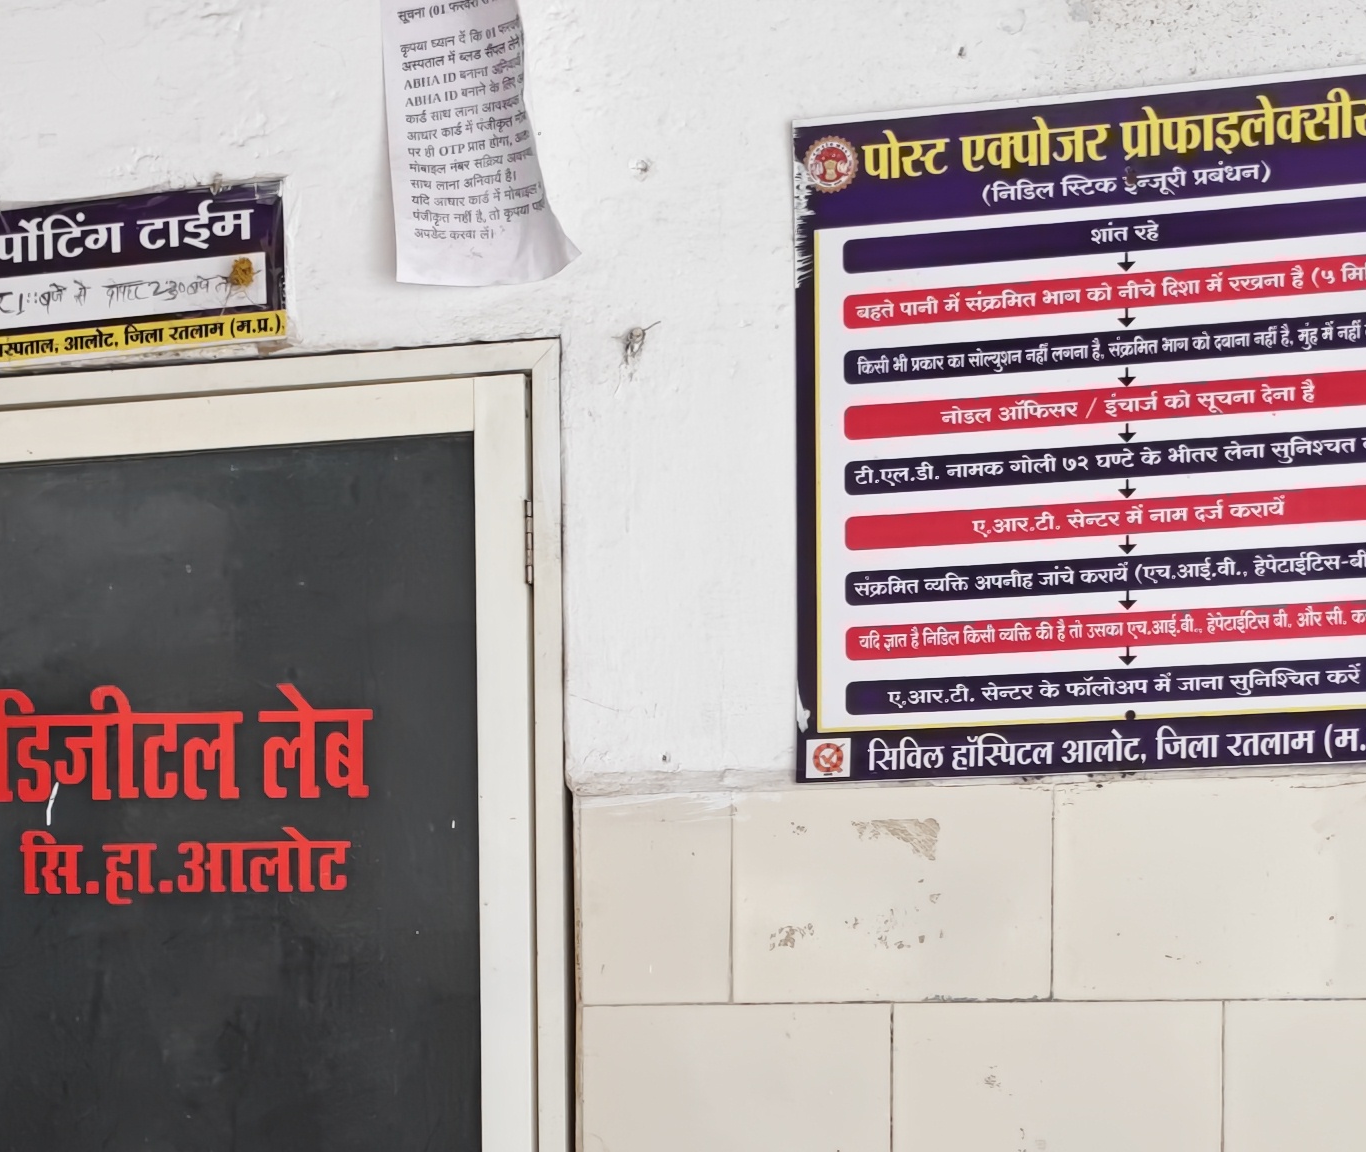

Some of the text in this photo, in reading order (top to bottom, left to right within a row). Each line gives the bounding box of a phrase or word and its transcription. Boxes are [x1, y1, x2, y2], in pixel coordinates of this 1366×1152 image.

[439, 144, 465, 156] OTP
[862, 130, 950, 180] पोस्ट
[982, 179, 1054, 207] (निडिल
[1062, 174, 1117, 197] स्टिक
[1192, 160, 1271, 186] प्रबंधन)
[137, 200, 254, 249] टाईम
[1090, 220, 1159, 245] शांत रहे
[856, 299, 894, 322] बहते
[900, 296, 938, 317] पानी
[944, 292, 960, 313] में
[965, 290, 1036, 311] संक्रमित
[1043, 286, 1080, 304] भाग
[1086, 282, 1112, 302] को
[1118, 279, 1155, 300] नीचे
[1162, 277, 1200, 297] दिशा
[1206, 272, 1222, 293] में
[1229, 273, 1285, 291] रखना
[1291, 266, 1305, 288] है
[124, 323, 164, 345] जिला
[169, 320, 224, 342] रतलाम
[941, 406, 992, 424] नोडल
[998, 401, 1078, 421] ऑफिसर
[1105, 393, 1158, 417] इंचार्ज
[1164, 390, 1191, 409] को
[1197, 389, 1255, 415] सूचना
[1261, 384, 1295, 404] देना
[1301, 379, 1315, 403] है
[972, 495, 1285, 538] ए.आर.टी. सेन्टर में नाम दर्ज करायें
[258, 682, 373, 799] लेब
[868, 736, 944, 771] सिविल
[951, 732, 1054, 771] हॉस्पिटल
[1061, 728, 1146, 765] आलोट,
[1156, 725, 1219, 760] जिला
[1227, 729, 1315, 757] रतलाम
